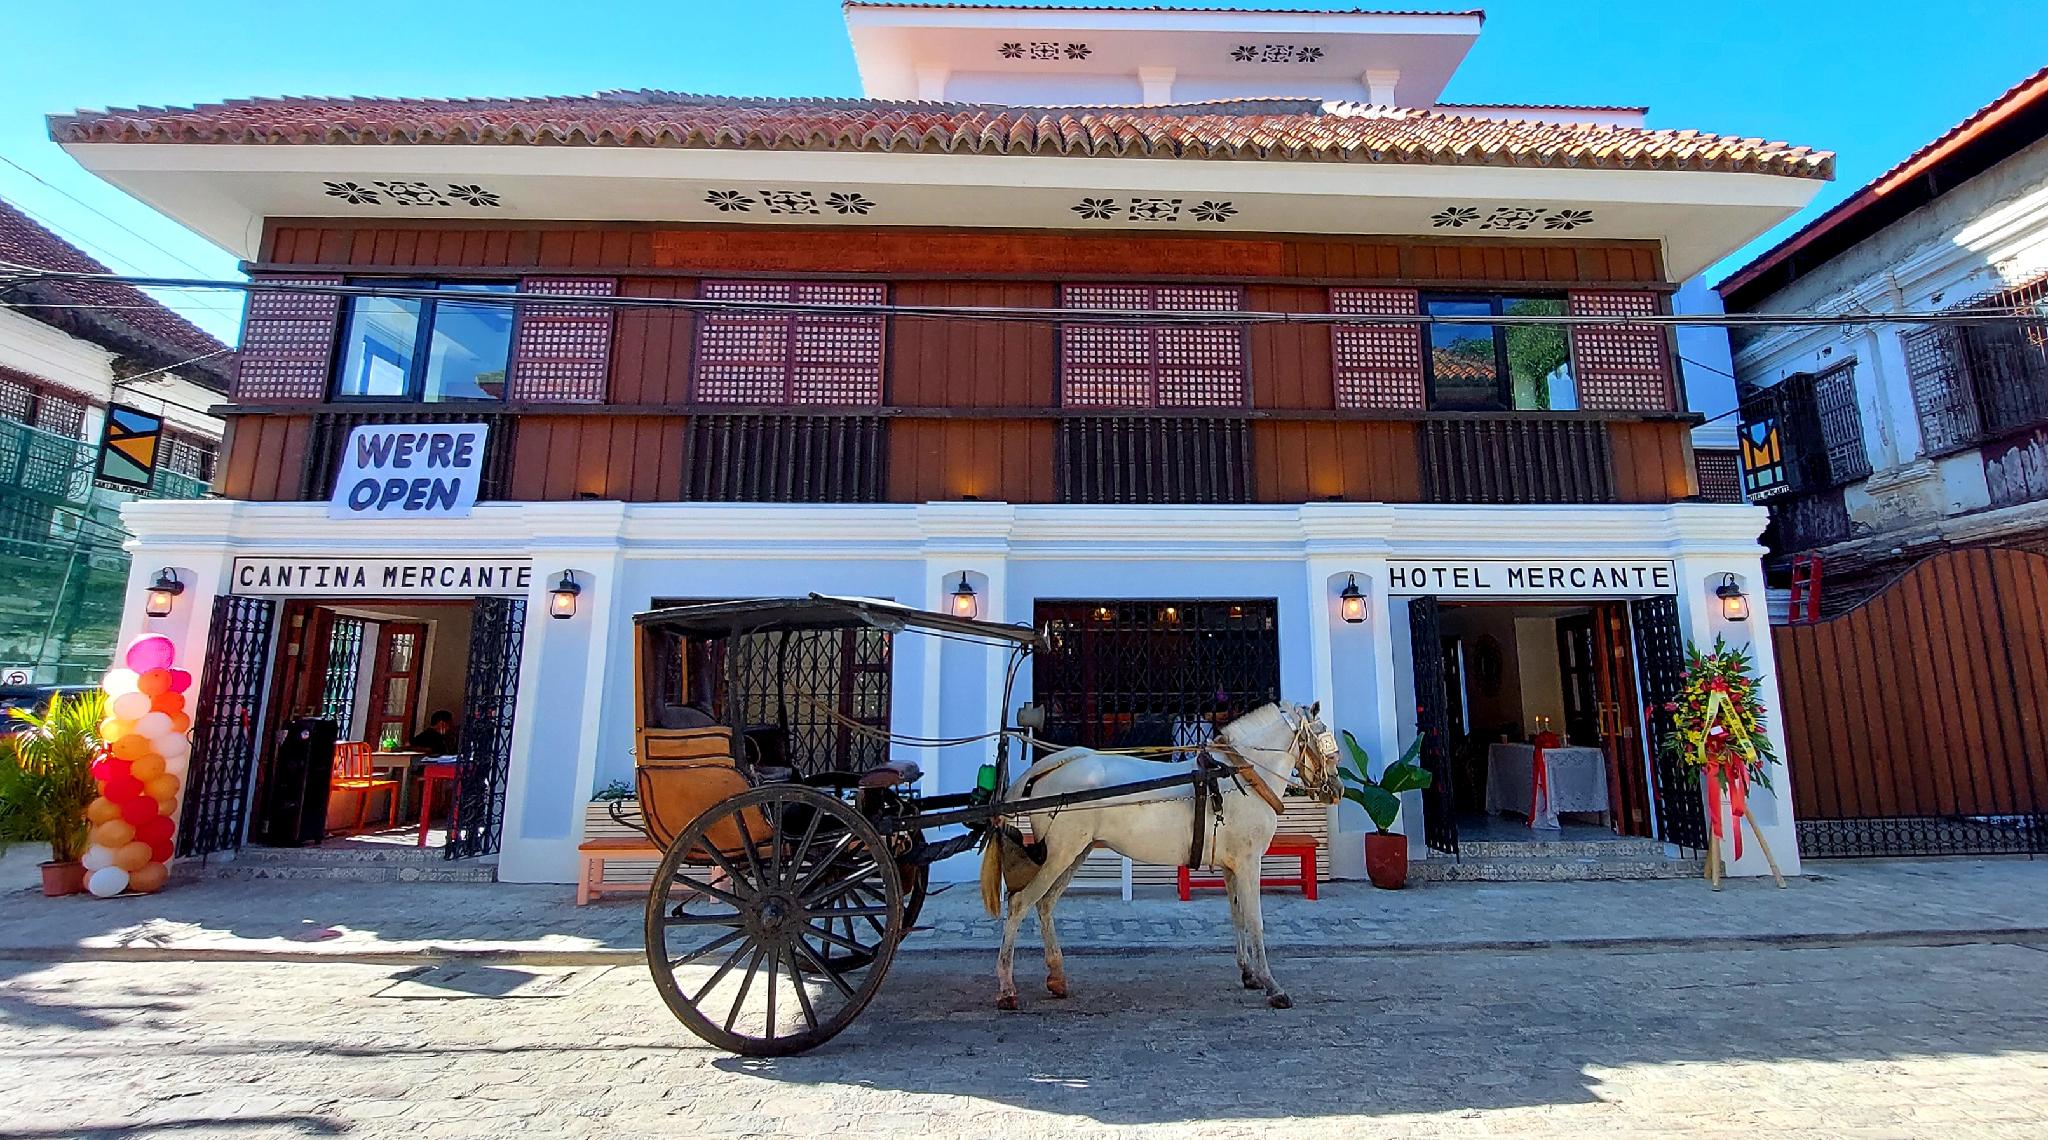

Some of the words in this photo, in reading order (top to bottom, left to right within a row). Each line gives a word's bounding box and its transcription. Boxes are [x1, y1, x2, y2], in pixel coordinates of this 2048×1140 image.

[357, 432, 476, 470] WE'RE
[348, 477, 462, 512] OPEN
[240, 565, 366, 588] CANTINA
[382, 566, 532, 588] MERCANTE
[1389, 567, 1491, 588] HOTEL
[1507, 567, 1670, 588] MERCANTE
